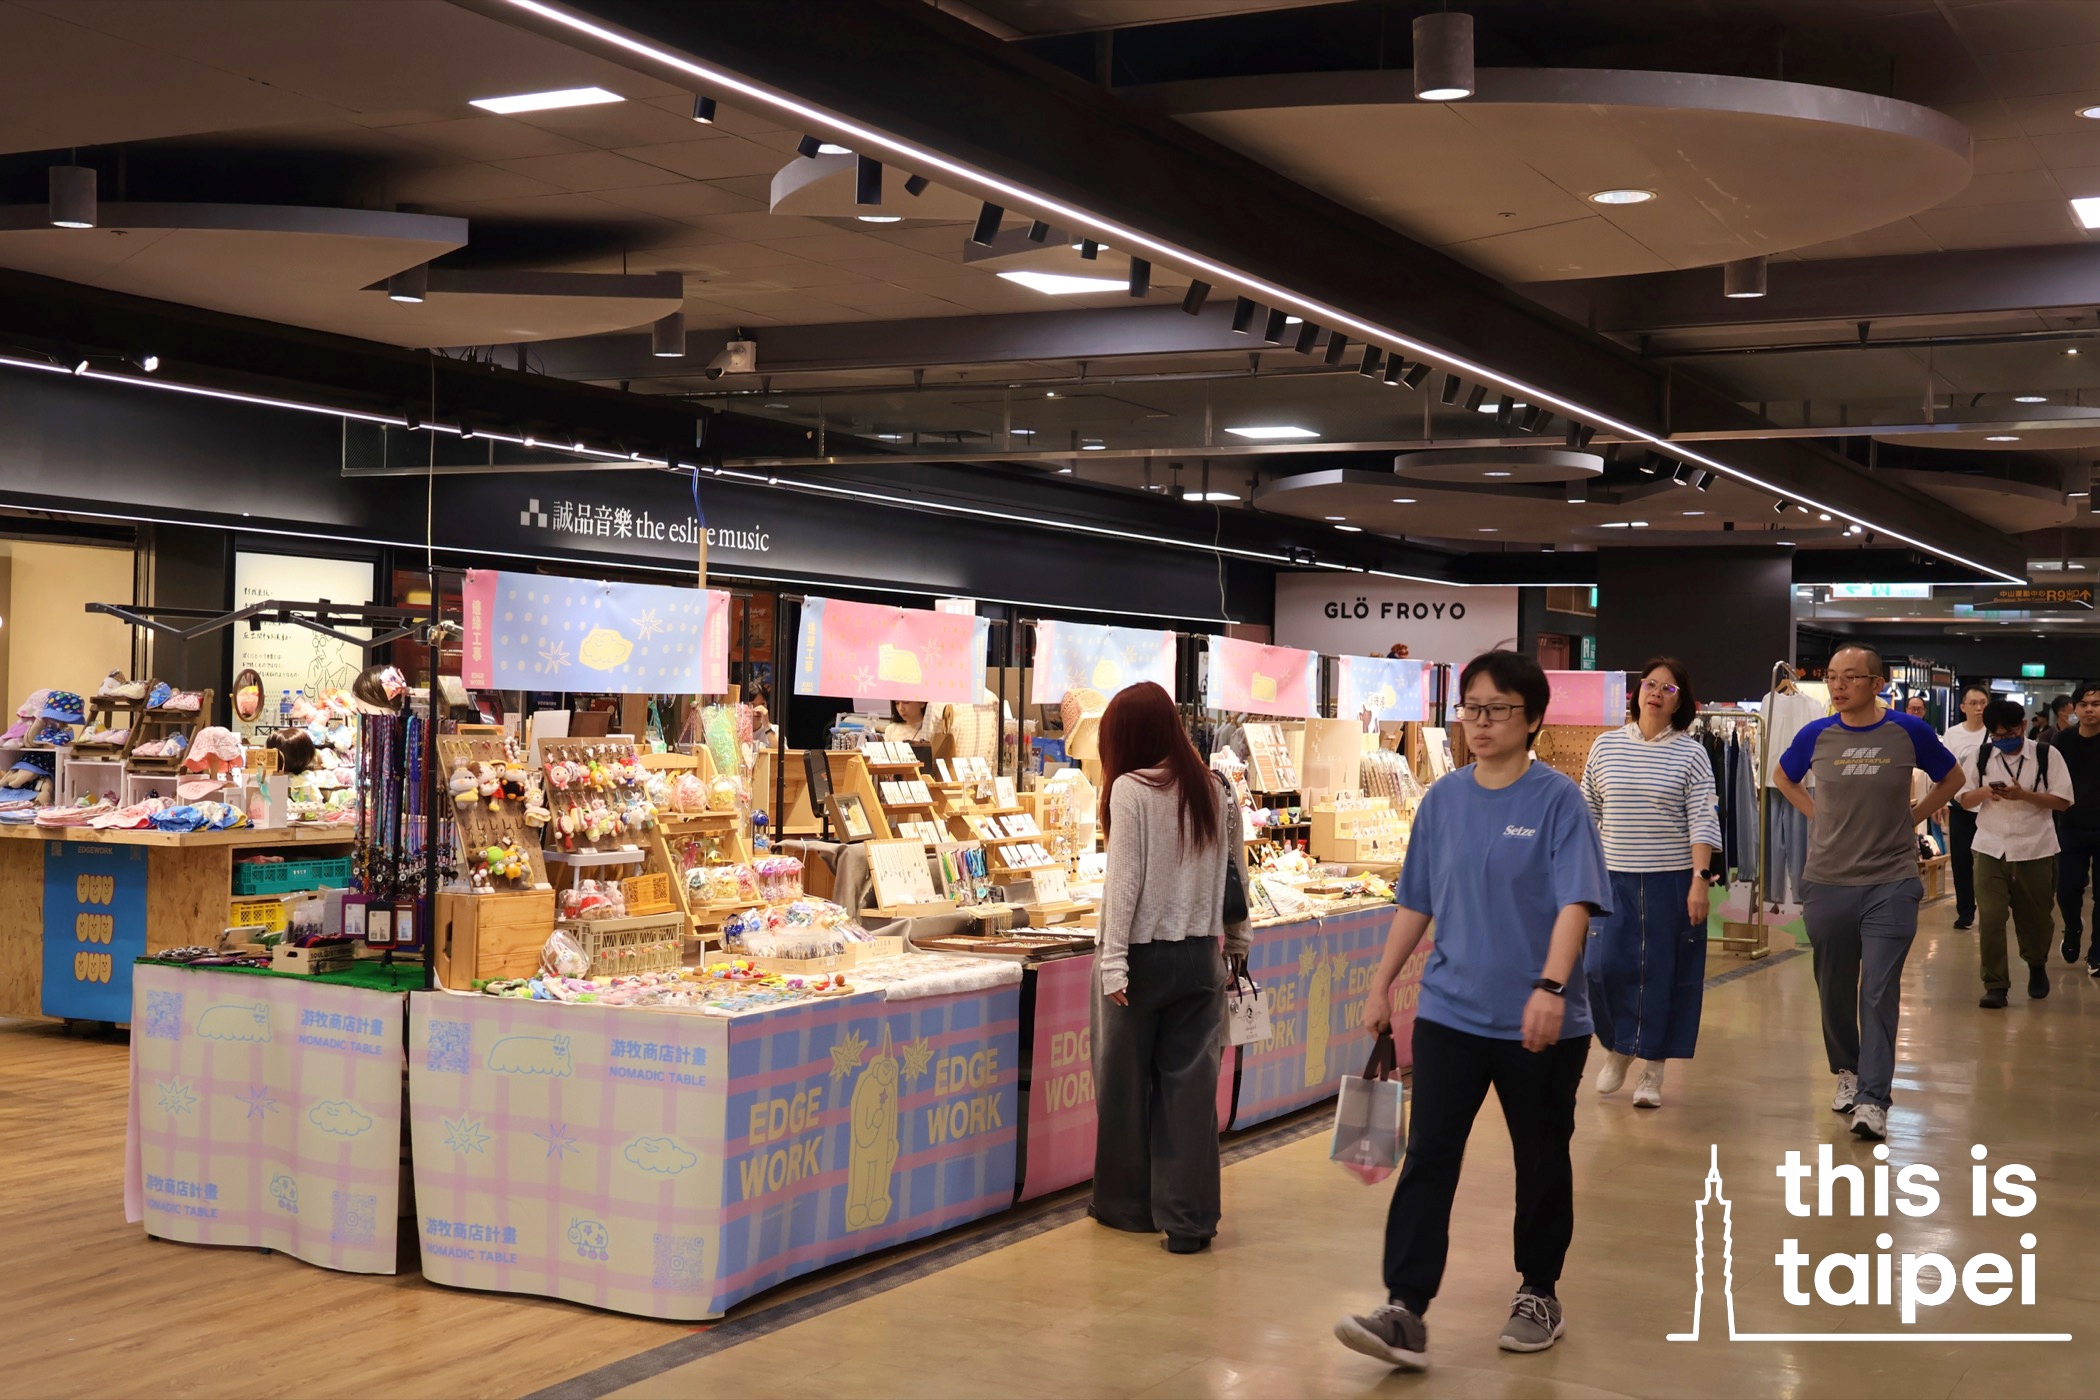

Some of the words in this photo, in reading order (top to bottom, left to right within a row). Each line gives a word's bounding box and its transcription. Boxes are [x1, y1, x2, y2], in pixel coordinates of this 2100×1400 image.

[552, 501, 632, 539] 誠品音樂
[636, 511, 665, 540] the
[668, 516, 716, 546] eslie
[718, 525, 770, 552] music
[1324, 597, 1369, 619] GLÖ
[1381, 602, 1466, 619] FROYO
[1348, 962, 1379, 995] EDG
[1264, 982, 1295, 1016] DGE
[1394, 983, 1421, 1012] WOR
[300, 1008, 384, 1037] 游牧商店計畫
[299, 1034, 346, 1051] NOMADIC
[350, 1041, 383, 1056] TABLE
[610, 1039, 706, 1066] 游牧商店計畫
[1050, 1026, 1091, 1069] EDG
[609, 1066, 665, 1082] NOMADIC
[669, 1072, 706, 1087] TABLE
[934, 1048, 998, 1097] EDGE
[1045, 1070, 1095, 1113] WOR
[749, 1086, 823, 1147] EDGE
[927, 1092, 1003, 1145] WORK
[739, 1136, 823, 1200] WORK
[184, 1205, 218, 1218] TABLE
[426, 1217, 518, 1245] 游牧商店計畫
[426, 1242, 475, 1260] NOMADIC
[479, 1250, 517, 1264] TABLE
